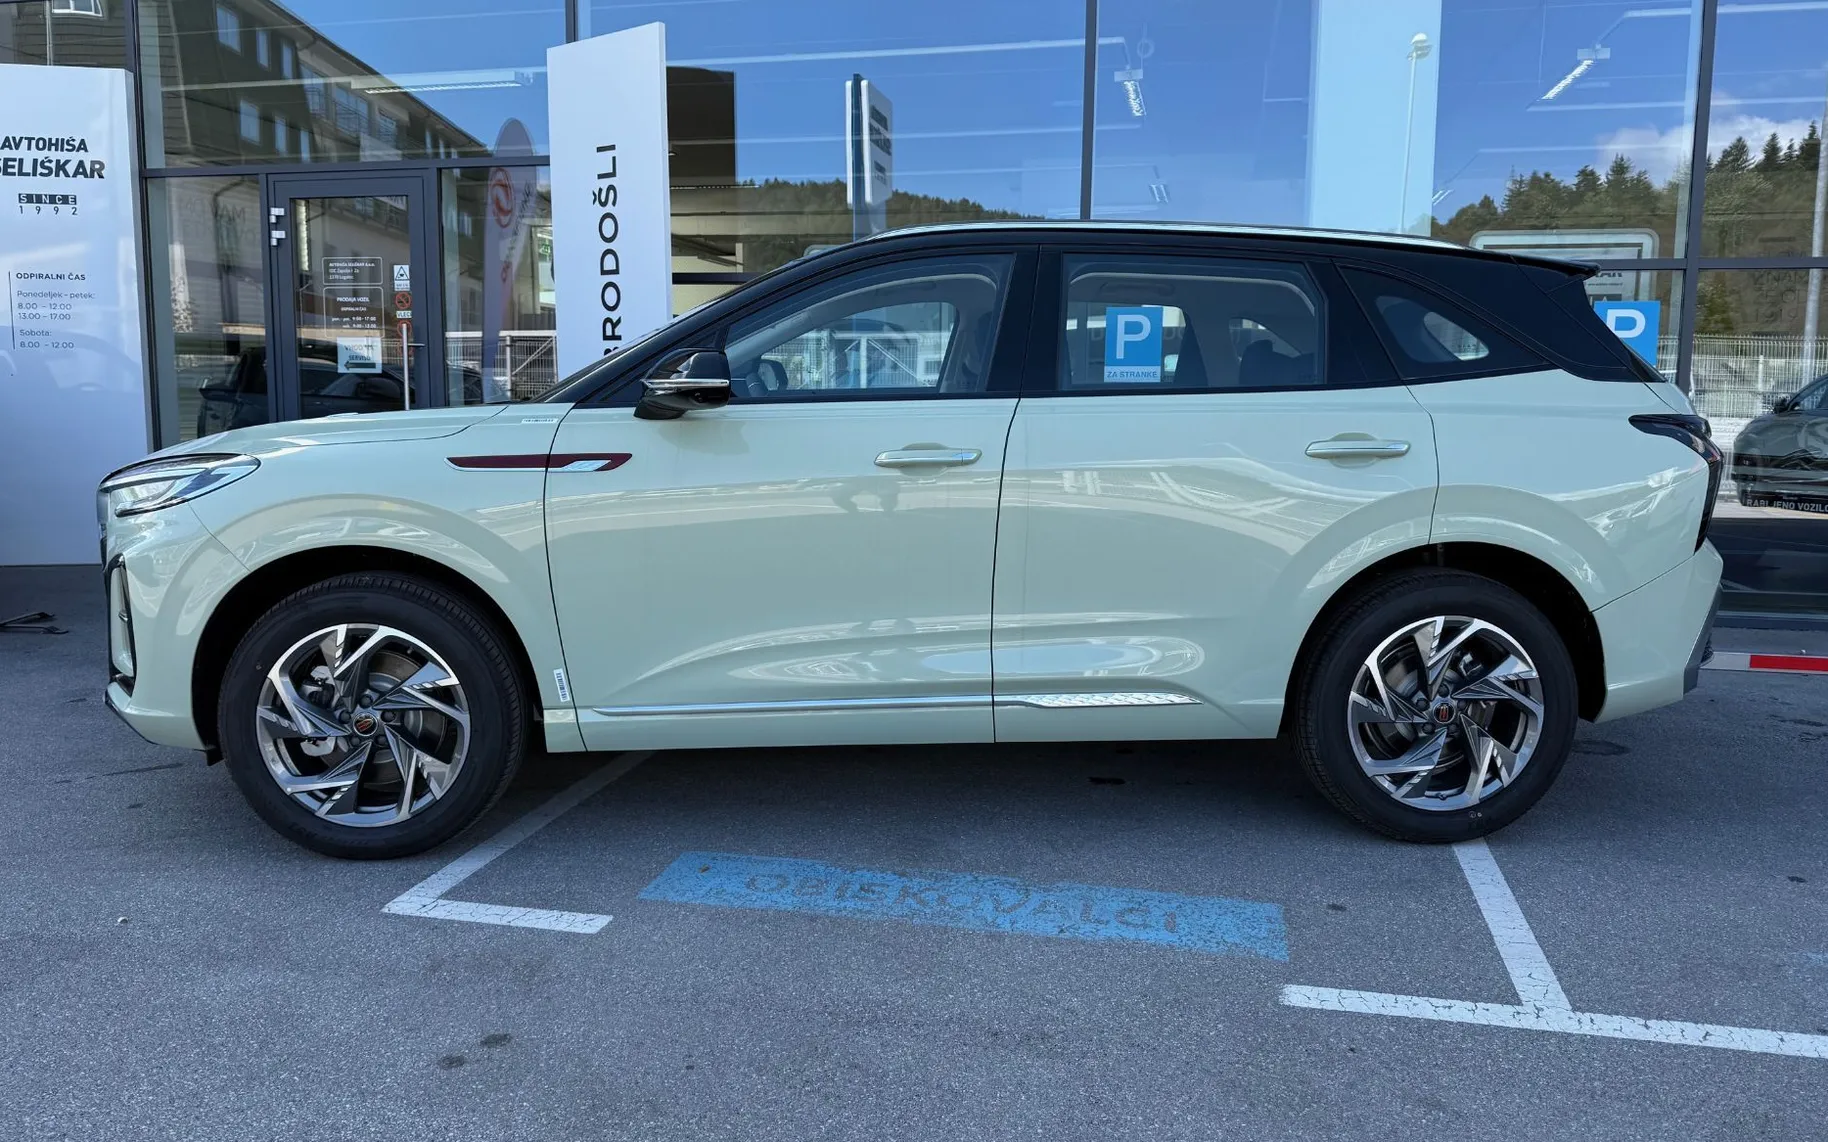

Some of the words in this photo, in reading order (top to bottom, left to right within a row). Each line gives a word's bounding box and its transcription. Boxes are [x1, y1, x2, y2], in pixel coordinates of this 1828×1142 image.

[0, 136, 88, 153] AVTOHIŠA
[0, 156, 105, 179] ELIŠKAR
[20, 194, 76, 204] SINCE
[19, 205, 78, 215] 1992
[16, 272, 65, 280] ODPIRALNI
[67, 272, 86, 281] ČAS
[17, 291, 62, 299] Ponedeljek
[69, 292, 95, 300] petek:
[19, 329, 52, 337] Sobota:
[1116, 315, 1151, 359] P
[19, 341, 40, 349] 8.00
[51, 341, 75, 349] 12.00
